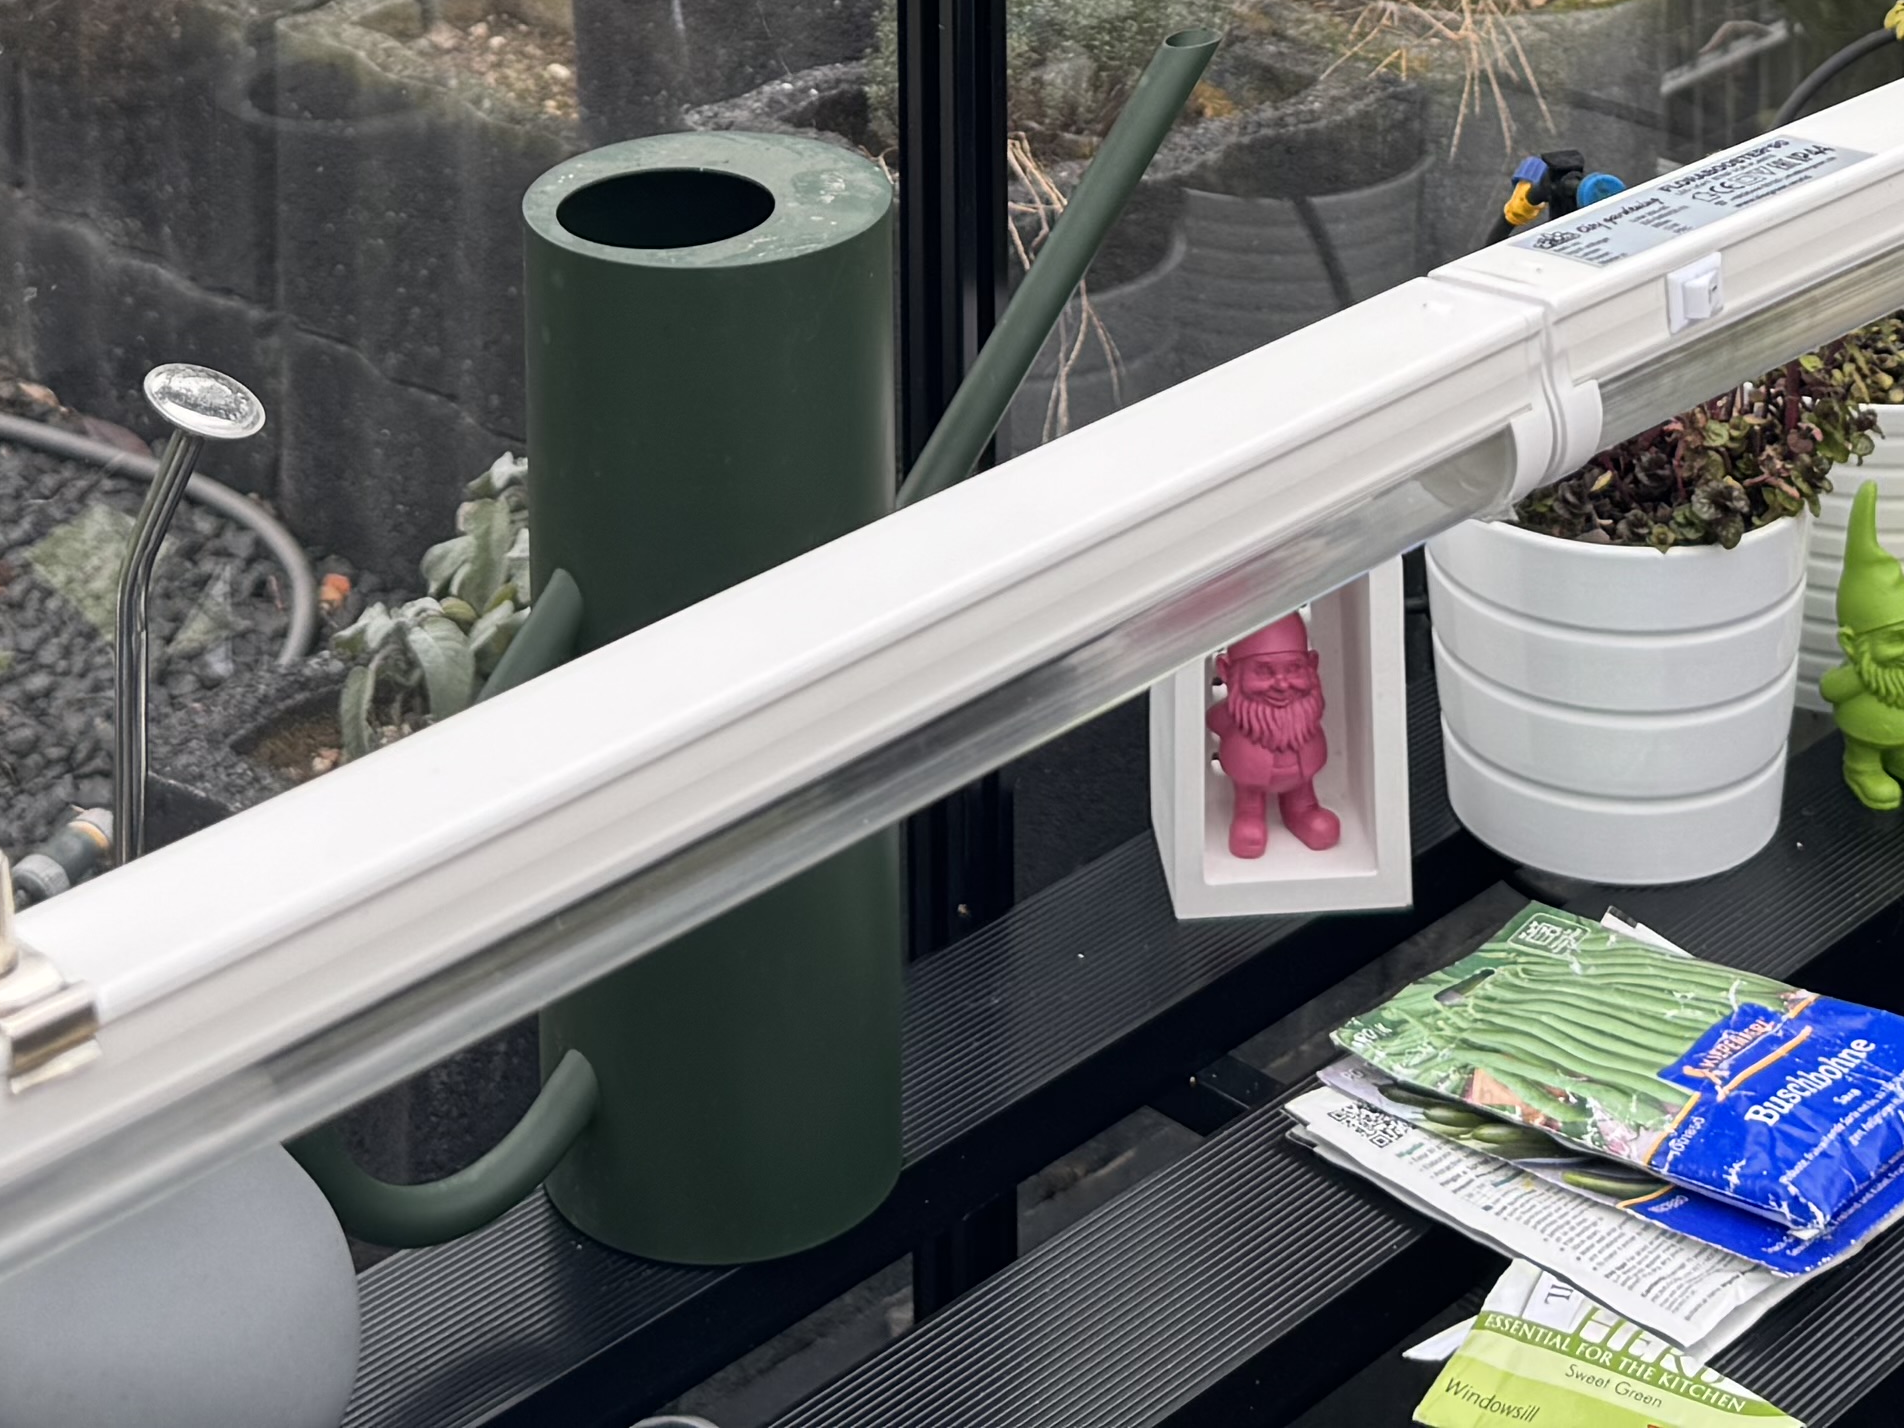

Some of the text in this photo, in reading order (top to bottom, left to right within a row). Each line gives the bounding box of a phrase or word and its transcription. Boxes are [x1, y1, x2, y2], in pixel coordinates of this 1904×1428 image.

[1744, 1039, 1876, 1127] Buschbohne
[1484, 1314, 1746, 1413] ESSENTIAL FOR THE KITCHEN
[1565, 1362, 1663, 1408] Sweet Green
[1444, 1376, 1541, 1424] Windowsill
